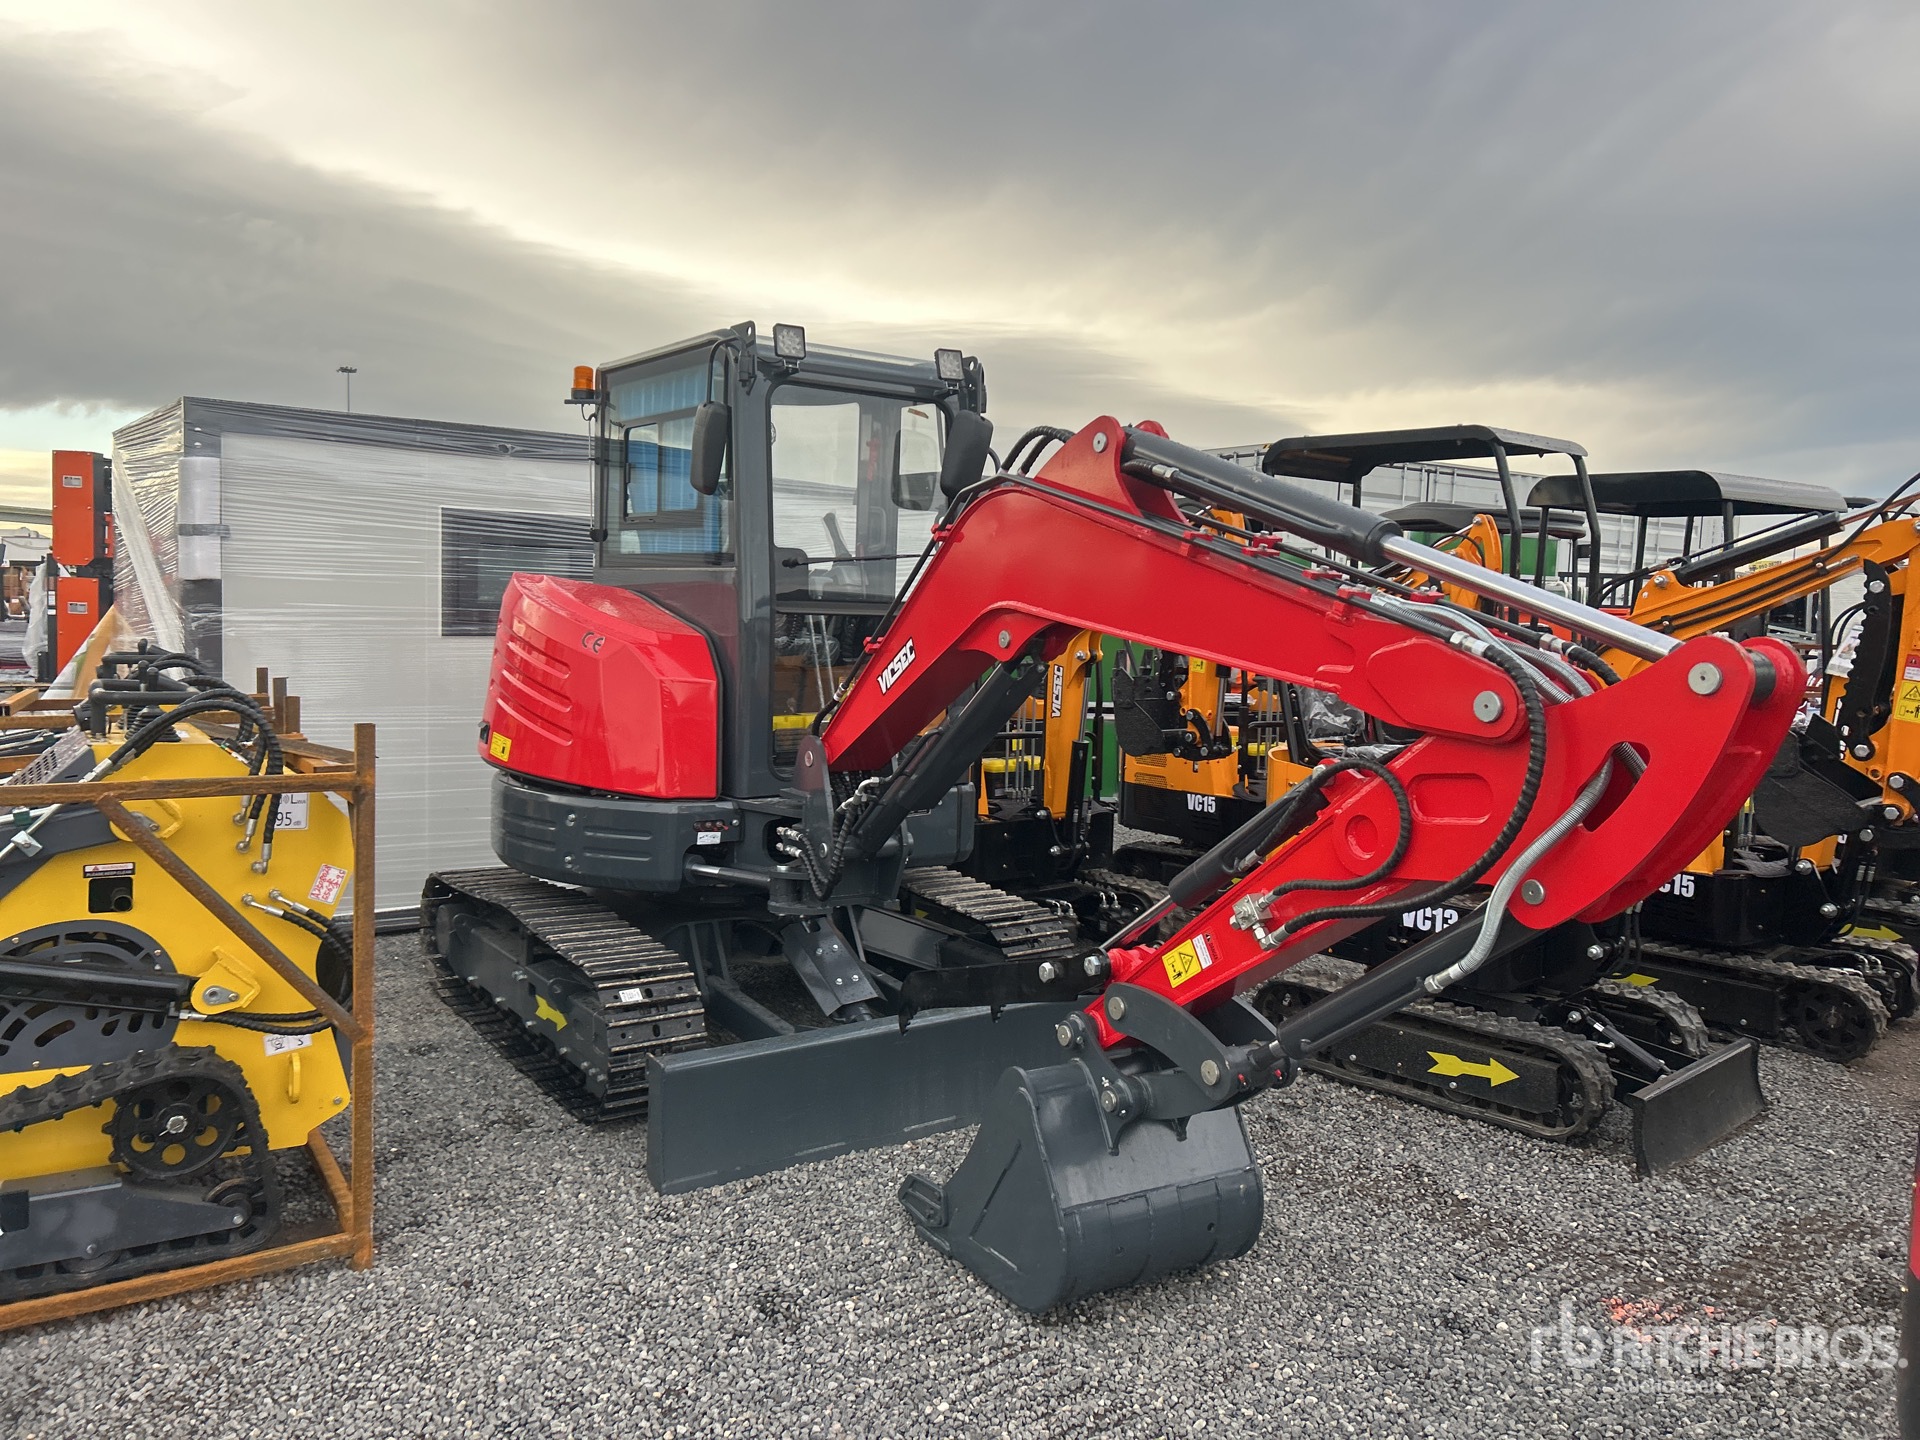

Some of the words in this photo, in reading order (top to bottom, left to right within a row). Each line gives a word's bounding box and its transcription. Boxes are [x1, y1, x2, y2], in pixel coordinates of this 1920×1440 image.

[876, 637, 916, 695] VICSEC
[1051, 664, 1064, 718] VICSEC
[1186, 793, 1216, 813] VC15
[1402, 906, 1459, 933] VC13
